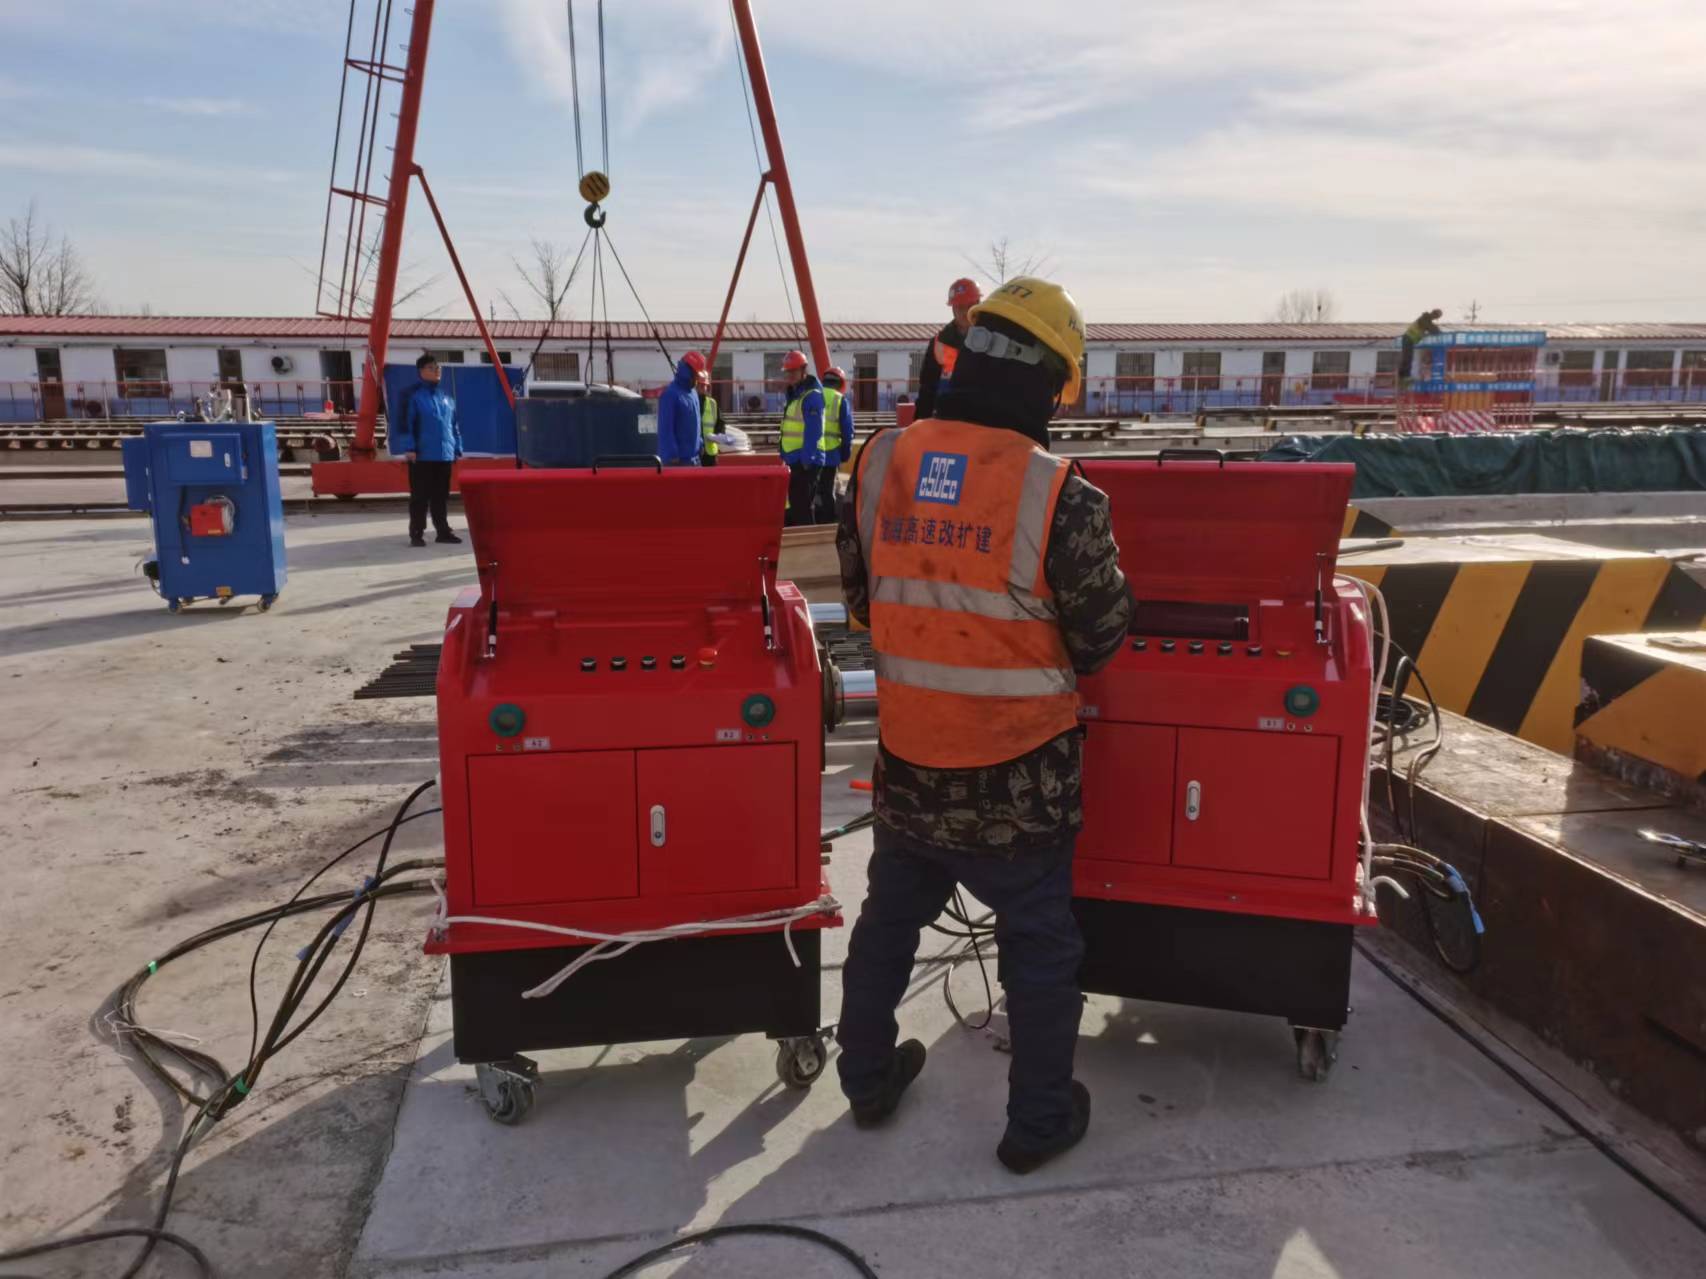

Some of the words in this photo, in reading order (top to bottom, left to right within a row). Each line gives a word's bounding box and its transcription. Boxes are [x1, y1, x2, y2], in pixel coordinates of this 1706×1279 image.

[881, 515, 992, 553] 高速改扩建
